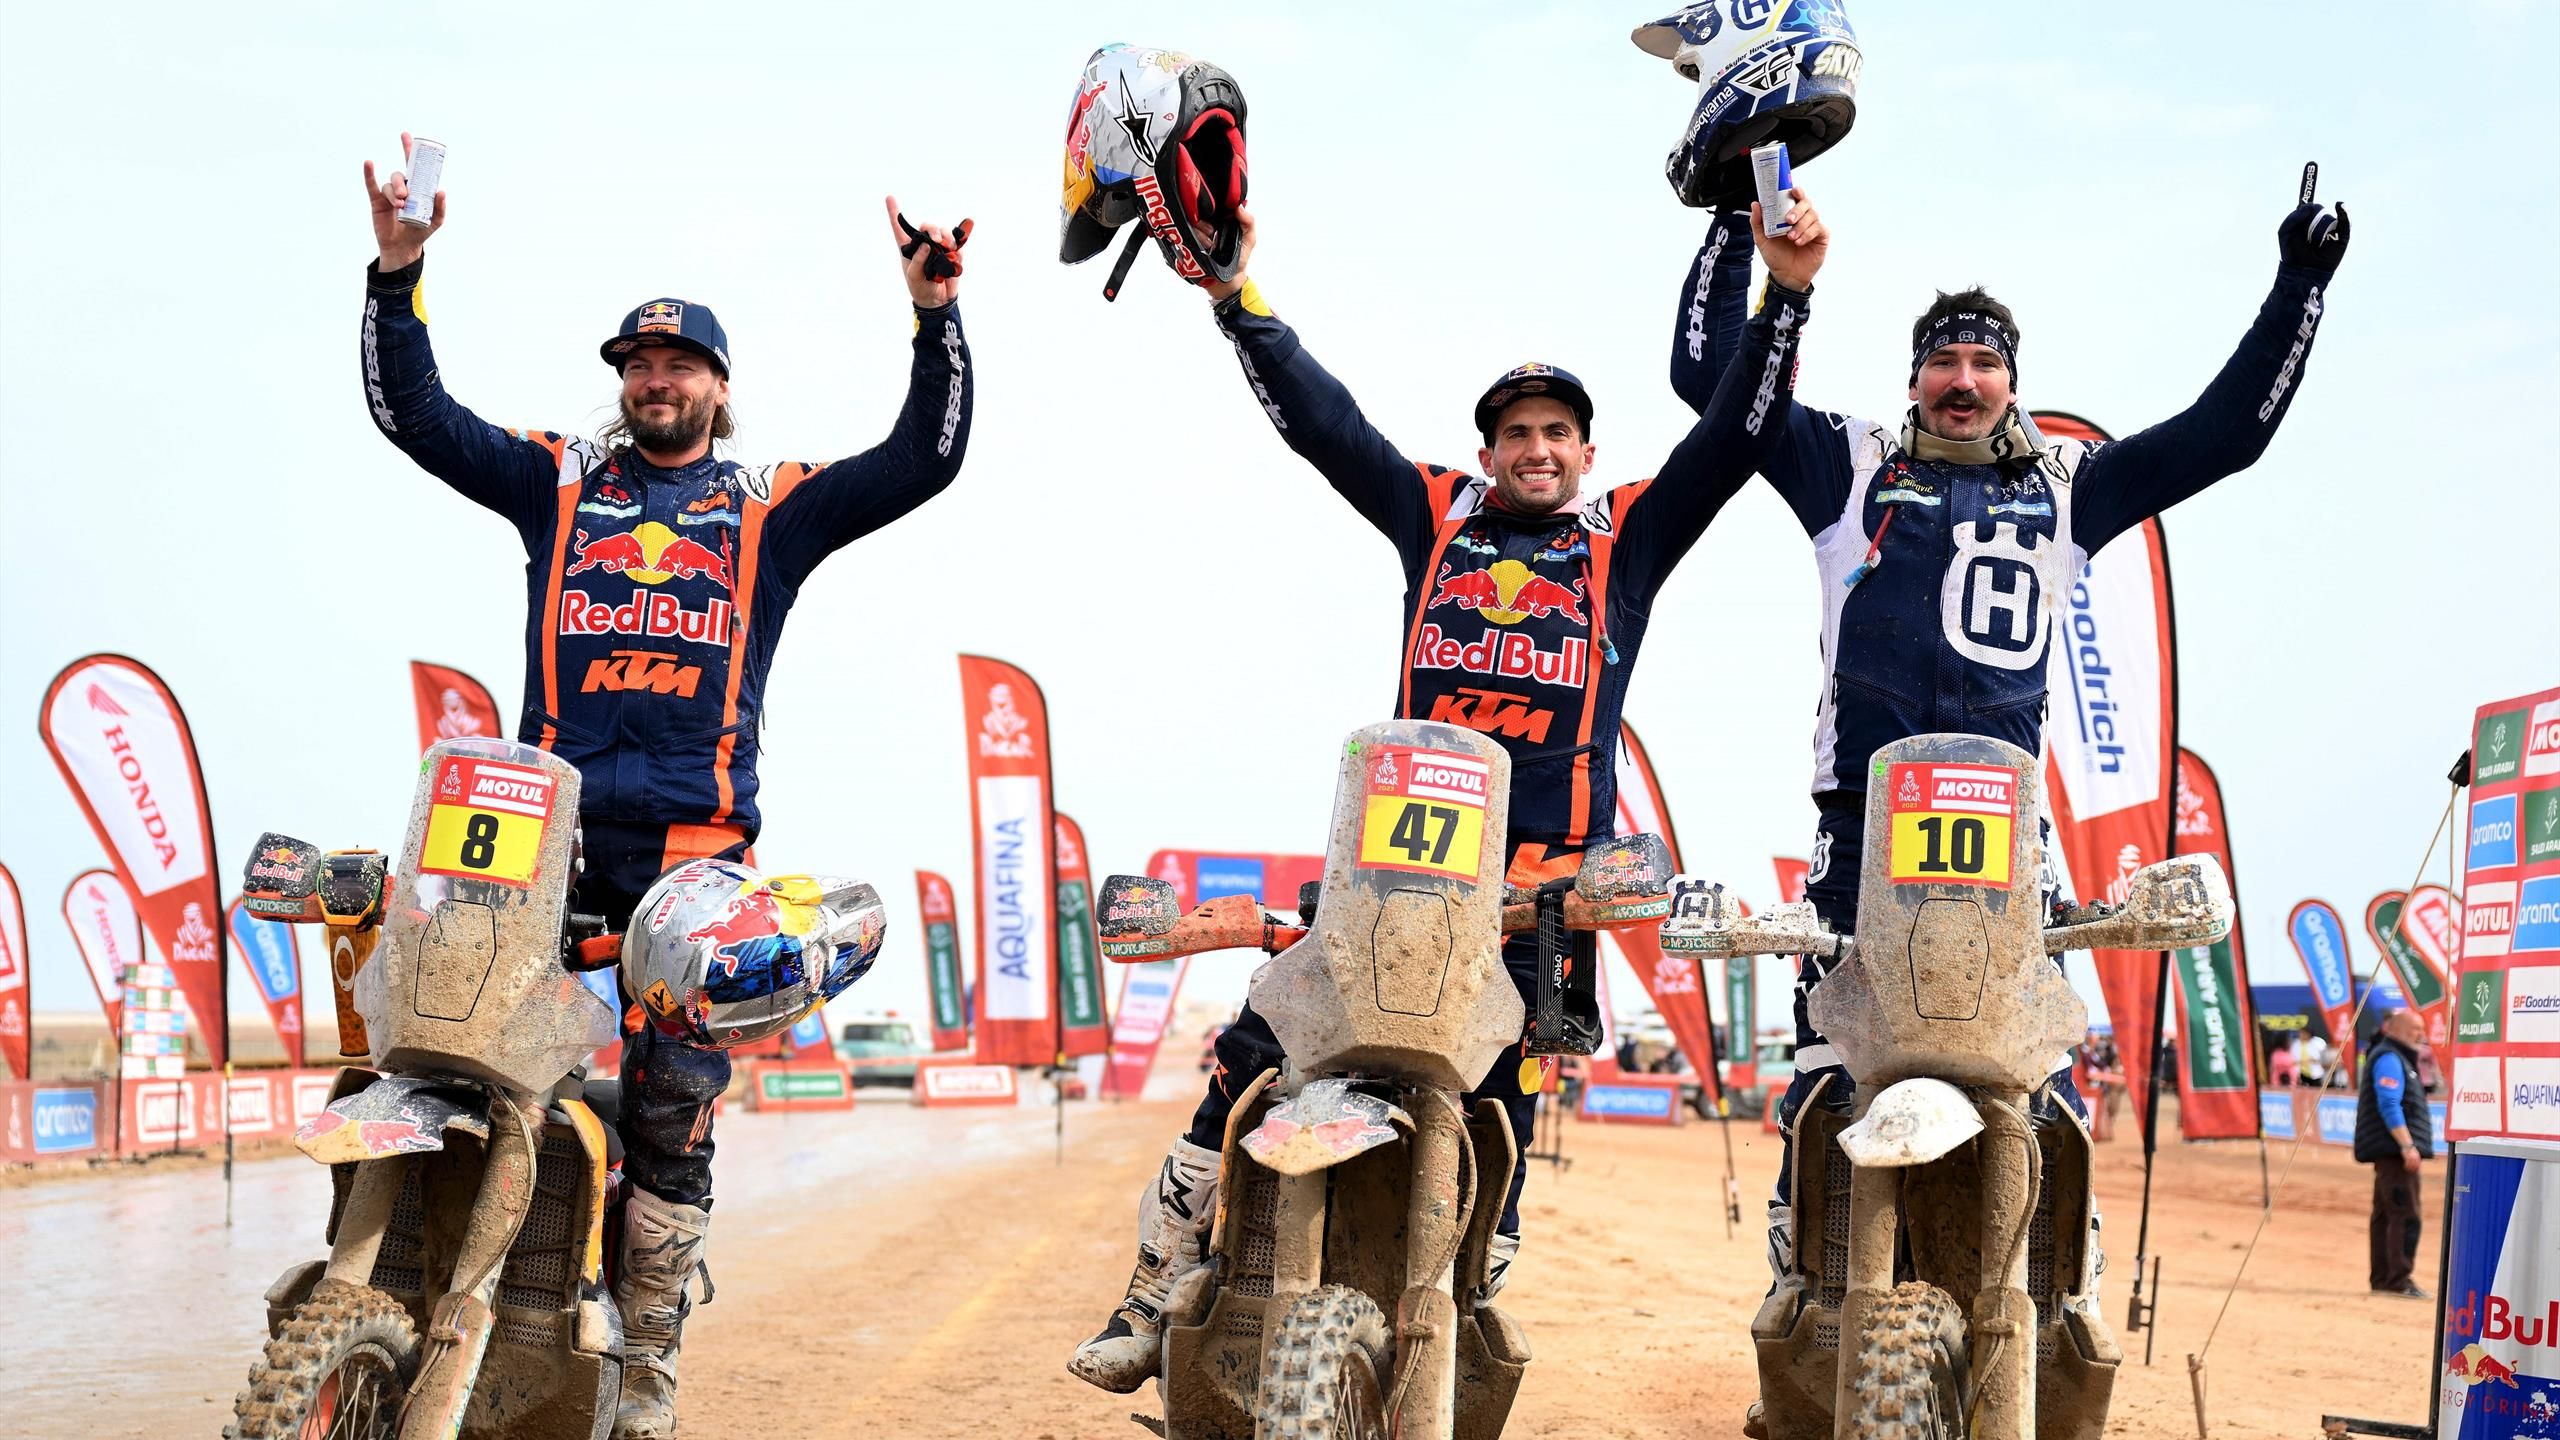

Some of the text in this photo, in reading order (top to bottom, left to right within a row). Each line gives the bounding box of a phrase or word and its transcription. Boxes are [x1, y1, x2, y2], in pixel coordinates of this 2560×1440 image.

[1725, 52, 1748, 72] Skyler
[1686, 85, 1735, 147] Husqvarna
[1133, 176, 1206, 279] Red Bull
[1685, 226, 1728, 362] alpinestars
[363, 297, 398, 432] alpinestars
[1745, 303, 1795, 436] alpinestars
[2259, 286, 2321, 423] alpinestars
[937, 320, 966, 457] alpinestars
[560, 588, 731, 646] Red Bull
[1414, 624, 1587, 688] Red Bull
[581, 650, 702, 698] KTM
[1429, 687, 1554, 744] KTM
[1375, 773, 1398, 786] DAKAR
[1414, 766, 1483, 792] MOTUL
[2492, 761, 2515, 775] ARABIA
[102, 723, 180, 874] HONDA
[440, 783, 461, 796] DAKAR
[475, 778, 544, 803] MOTUL
[1898, 792, 1921, 802] DAKAR
[1936, 781, 2007, 801] MOTUL
[460, 813, 500, 870] 8
[1389, 802, 1460, 865] 47
[1918, 817, 1985, 874] 10
[2473, 821, 2512, 847] aramco
[251, 863, 304, 881] Red Bull
[1594, 868, 1626, 886] Red
[248, 897, 303, 914] MOTOREX
[653, 896, 677, 928] BELL
[996, 816, 1033, 980] AQUAFINA
[1109, 903, 1163, 920] Red Bull
[1613, 899, 1671, 919] MOTOREX
[173, 942, 217, 962] DAKAR
[2304, 910, 2345, 1001] aramco
[1554, 953, 1563, 989] OAKLEY
[686, 988, 697, 1006] Red
[2463, 1092, 2496, 1104] HONDA
[36, 1104, 89, 1138] aramco
